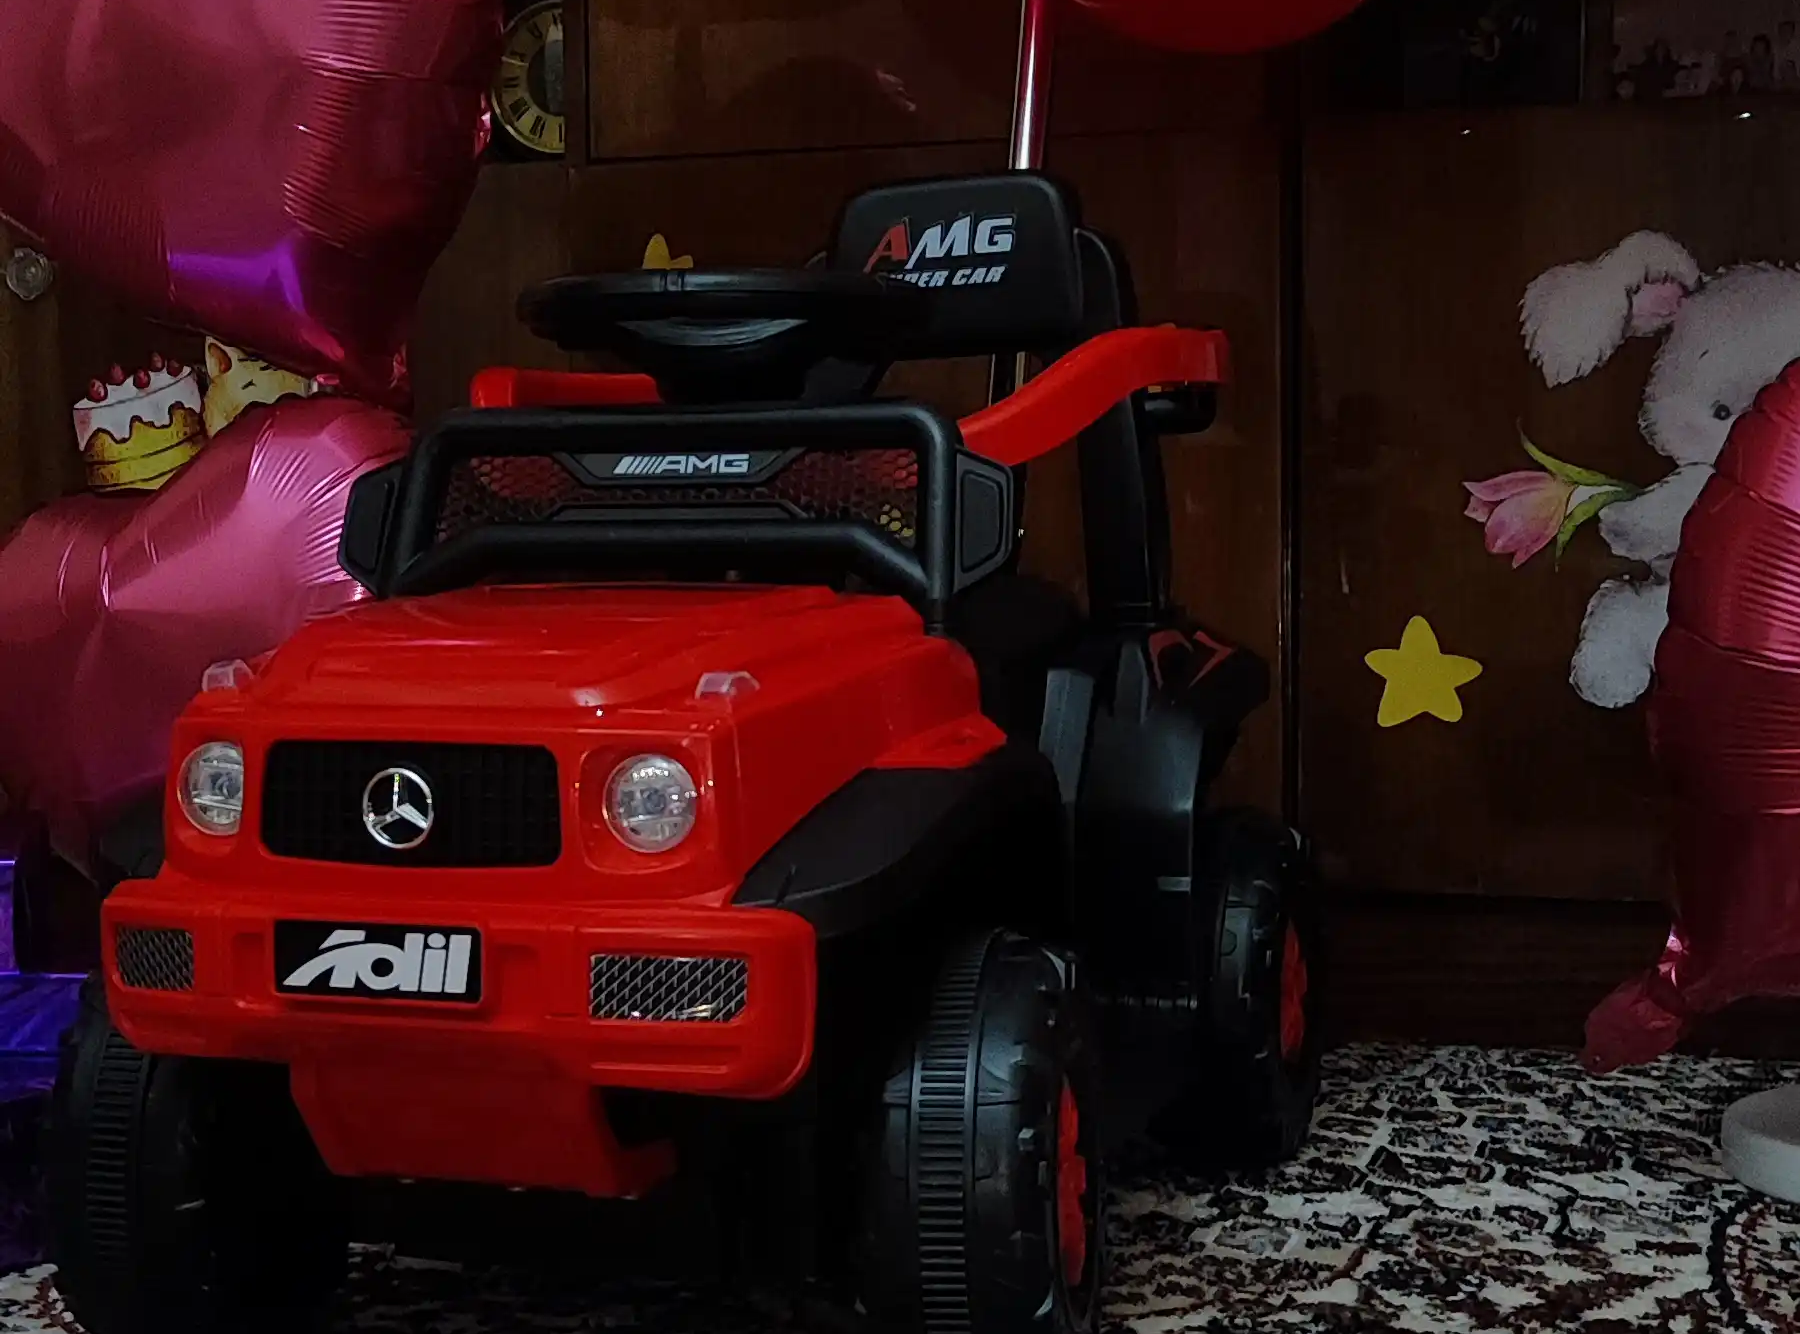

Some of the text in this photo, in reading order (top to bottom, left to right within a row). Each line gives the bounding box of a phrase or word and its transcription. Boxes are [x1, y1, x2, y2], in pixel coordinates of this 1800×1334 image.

[862, 216, 1013, 273] AMG
[889, 265, 1006, 288] PER CAR
[282, 929, 472, 994] Adil
